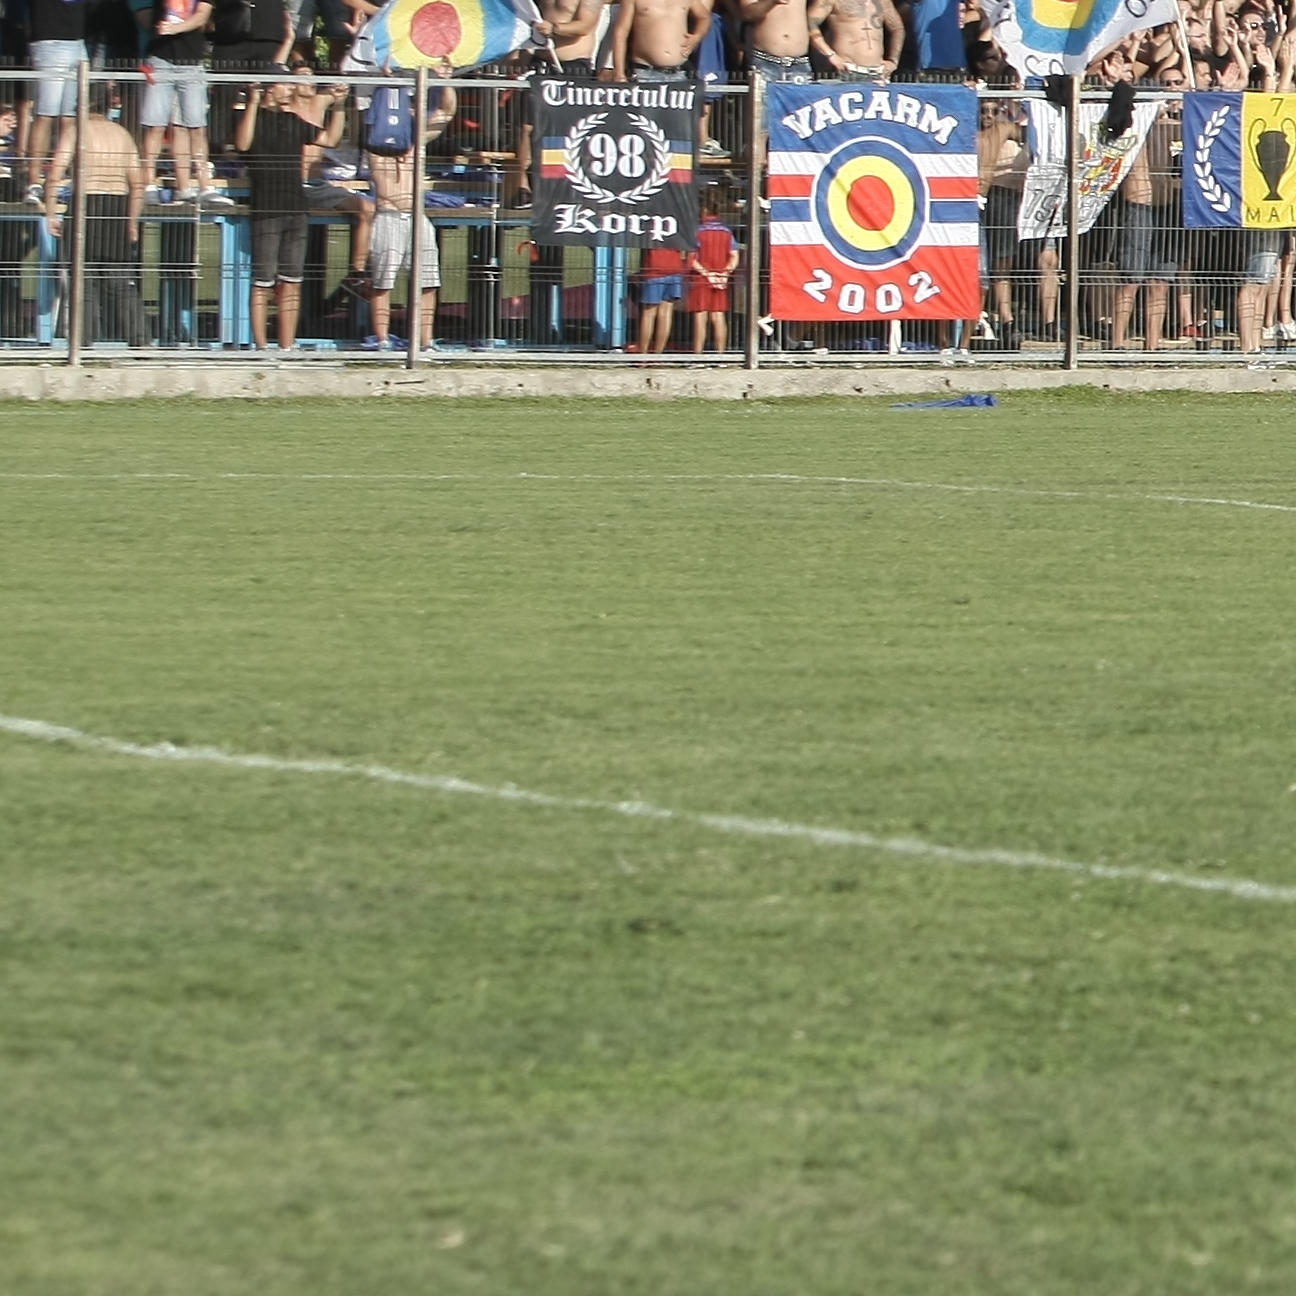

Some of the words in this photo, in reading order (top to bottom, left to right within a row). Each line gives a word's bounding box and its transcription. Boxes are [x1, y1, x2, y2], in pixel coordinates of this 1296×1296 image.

[781, 89, 960, 146] VACARM
[1269, 96, 1286, 118] 7
[587, 133, 647, 179] 98
[553, 204, 679, 243] Korp
[1244, 204, 1296, 225] MAI
[801, 267, 942, 315] 2002
